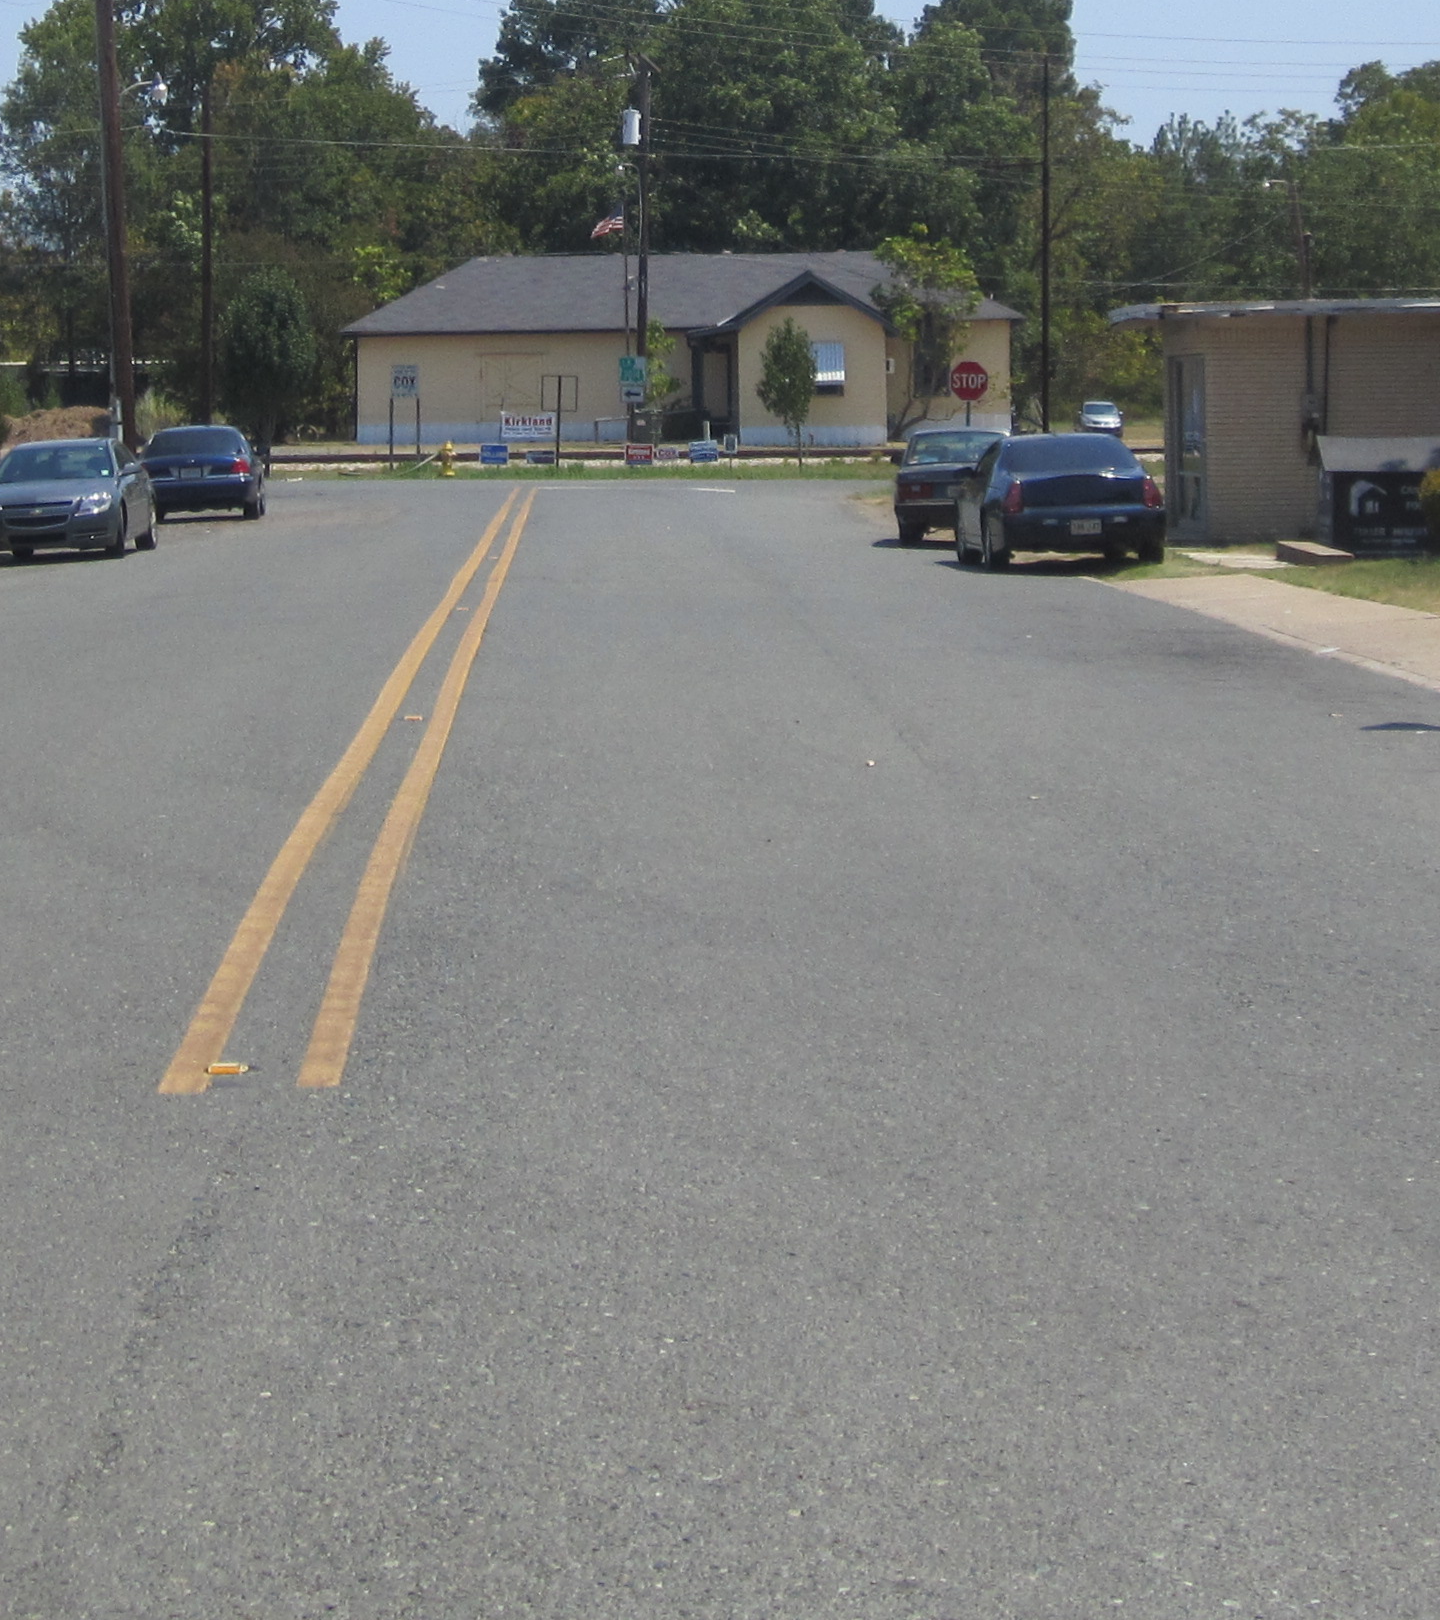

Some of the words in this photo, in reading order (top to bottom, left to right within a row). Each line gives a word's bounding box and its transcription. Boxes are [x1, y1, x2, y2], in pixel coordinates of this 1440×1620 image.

[393, 375, 417, 389] COX
[952, 373, 987, 389] STOP
[504, 416, 553, 426] Kirkland
